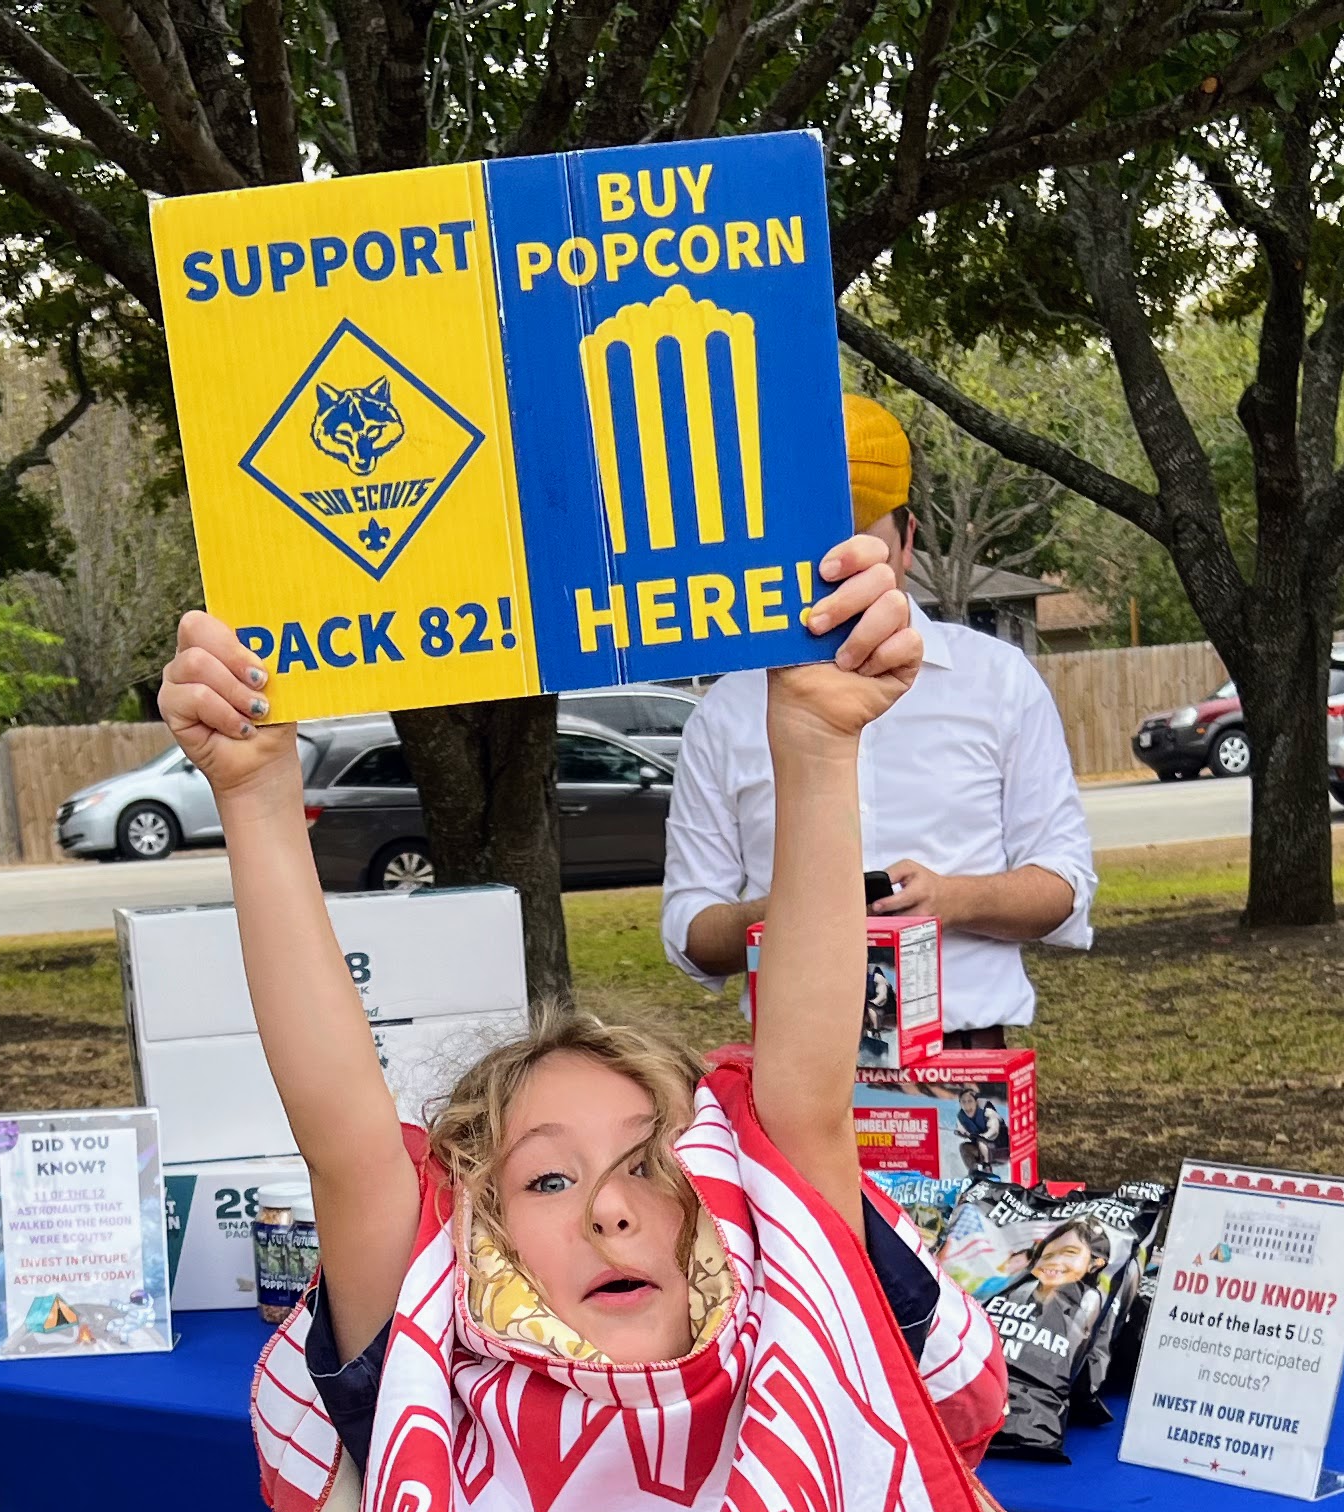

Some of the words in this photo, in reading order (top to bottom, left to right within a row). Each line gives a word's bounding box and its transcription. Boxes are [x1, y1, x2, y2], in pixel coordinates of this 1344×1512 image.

[598, 163, 714, 223] BUY
[182, 219, 476, 302] SUPPORT
[516, 216, 806, 292] POPCORN
[300, 487, 354, 516] CUB
[350, 477, 436, 512] SCOUTS
[574, 560, 813, 653] HERE!
[235, 611, 406, 674] PACK
[419, 596, 517, 658] 82!
[855, 1067, 911, 1083] THANK
[914, 1067, 952, 1083] YOU
[855, 1119, 928, 1133] UNBELIEVABLE
[31, 1138, 64, 1153] DID
[70, 1136, 109, 1151] YOU
[37, 1160, 106, 1176] KNOW?
[17, 1203, 91, 1216] ASTRONAUTS
[215, 1186, 260, 1219] 28
[1051, 1200, 1135, 1230] LEADERS
[9, 1220, 54, 1232] WALKED
[56, 1218, 72, 1229] ON
[76, 1217, 96, 1228] THE
[99, 1216, 132, 1227] MOON
[29, 1234, 62, 1245] WERE
[218, 1220, 256, 1230] SNA
[20, 1256, 62, 1268] INVEST
[65, 1256, 79, 1266] IN
[81, 1253, 128, 1265] FUTURE
[14, 1272, 91, 1285] ASTRONAUTS
[93, 1270, 136, 1281] TODAY!
[1173, 1269, 1209, 1295] DID
[1216, 1275, 1257, 1303] YOU
[1260, 1283, 1338, 1316] KNOW?
[1169, 1305, 1178, 1320] 4
[1180, 1309, 1205, 1326] out
[1207, 1312, 1224, 1328] of
[1226, 1314, 1250, 1333] the
[1253, 1318, 1282, 1339] last
[1285, 1323, 1296, 1340] 5
[1297, 1325, 1325, 1346] U.S.
[1158, 1333, 1232, 1358] presidents
[1233, 1346, 1322, 1374] participated
[1198, 1363, 1211, 1382] in
[1212, 1371, 1270, 1393] scouts?
[1152, 1392, 1198, 1414] INVEST
[1199, 1401, 1215, 1418] IN
[1217, 1405, 1246, 1424] OUR
[1248, 1411, 1301, 1435] FUTURE
[1167, 1425, 1221, 1449] LEADERS
[1224, 1437, 1275, 1461] TODAY!
